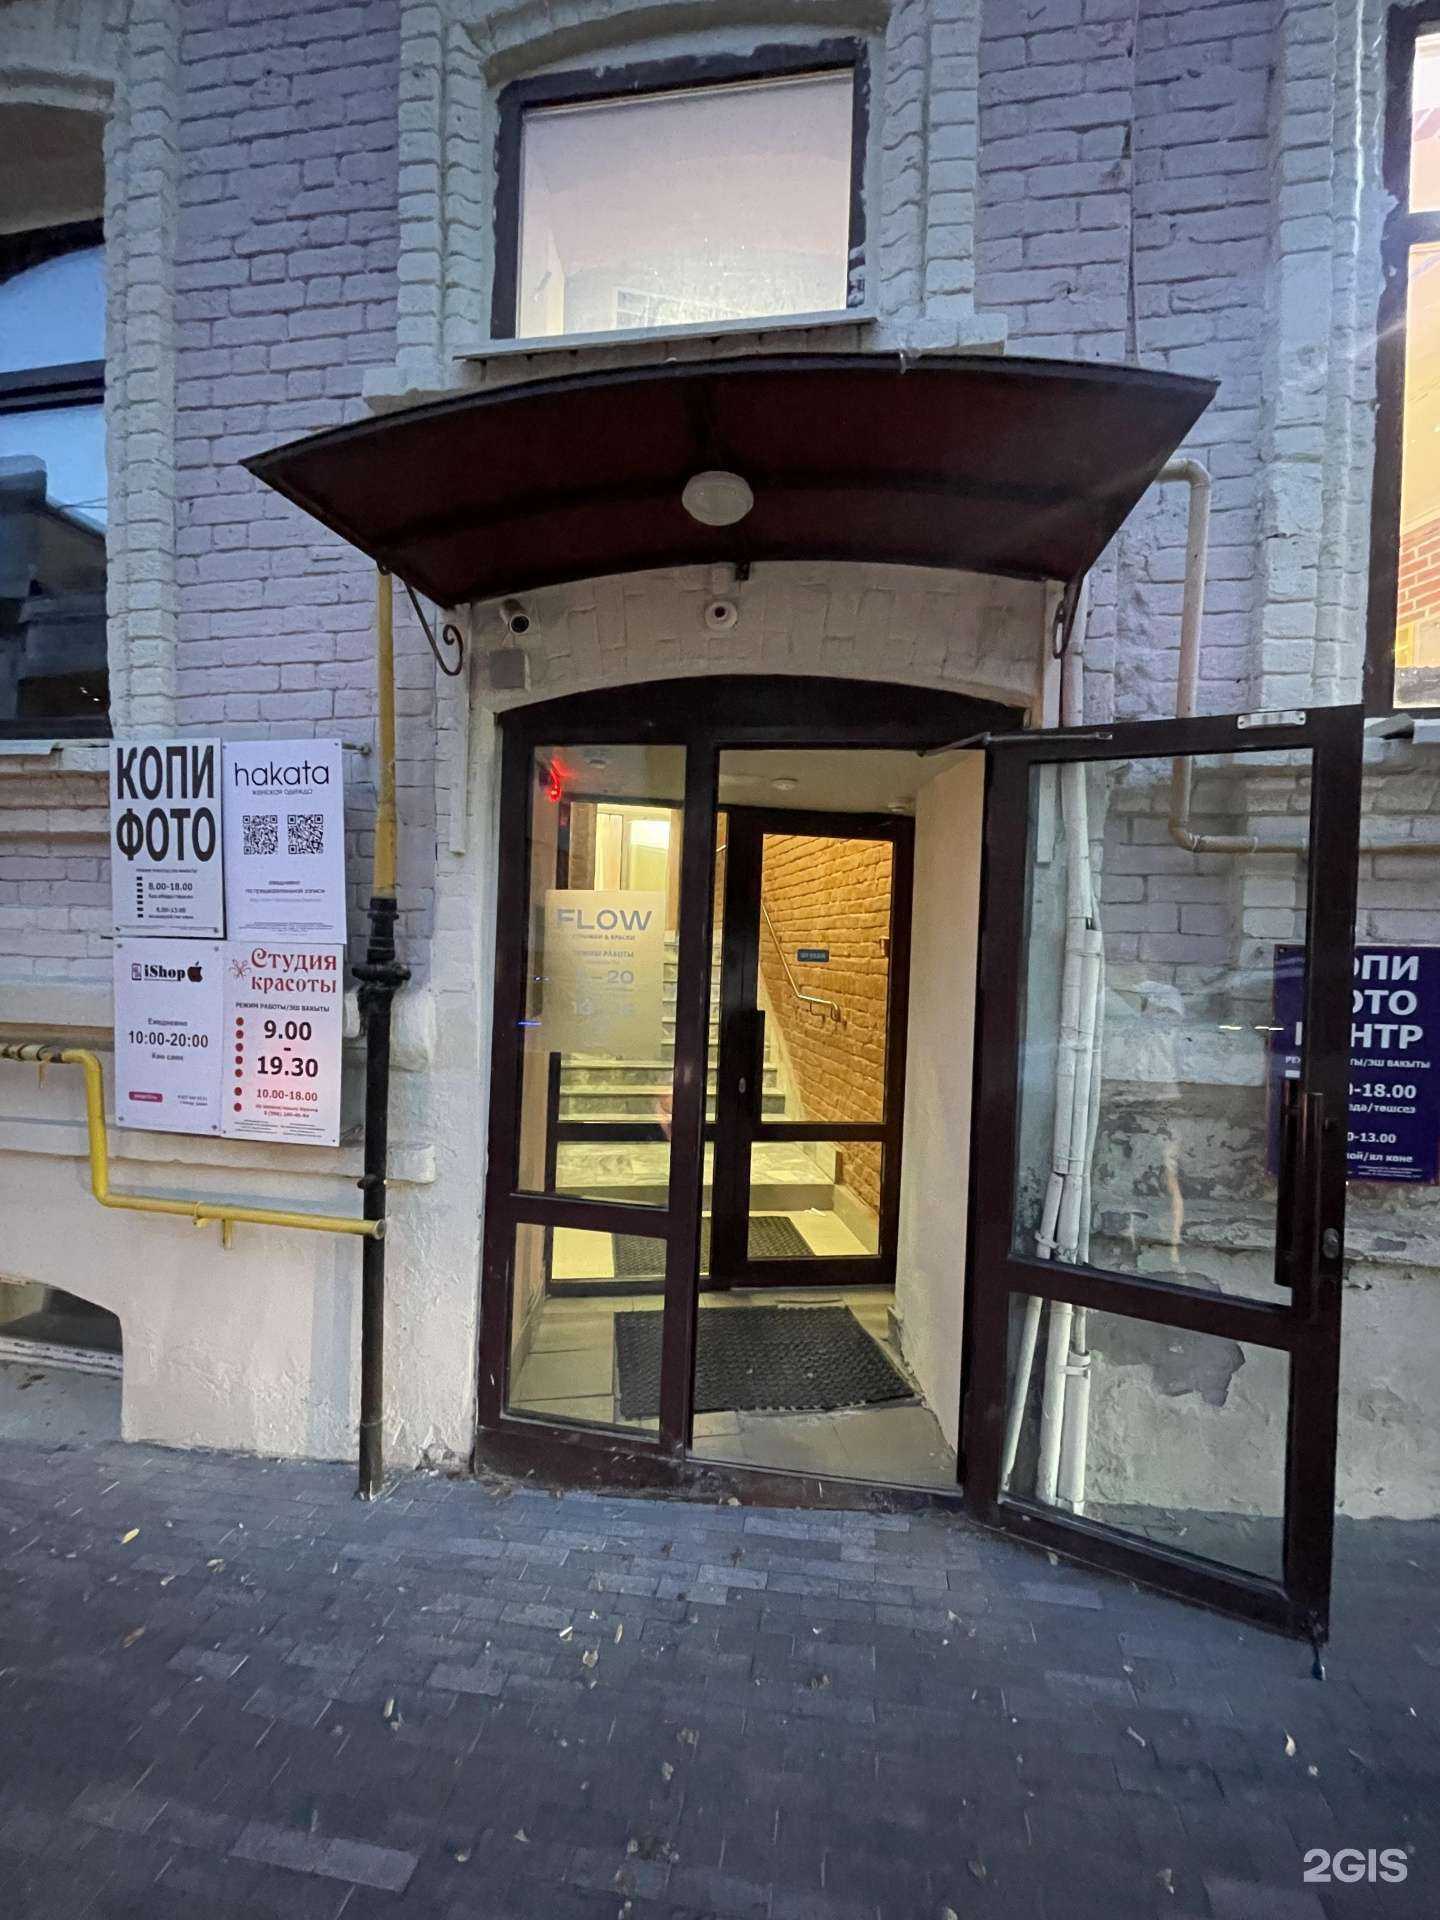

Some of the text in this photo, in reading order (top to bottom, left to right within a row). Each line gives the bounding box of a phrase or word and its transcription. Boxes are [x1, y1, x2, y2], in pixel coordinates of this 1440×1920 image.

[116, 745, 215, 801] КОПИ
[234, 760, 330, 787] hakata
[116, 806, 217, 863] ФОТО
[557, 909, 653, 931] FLOW
[250, 947, 337, 973] Студия
[1352, 954, 1420, 981] ПИ
[144, 963, 186, 981] iShop
[250, 975, 337, 994] красоты
[128, 1030, 209, 1048] 10:00-20:00
[263, 1019, 312, 1041] 9.00
[256, 1056, 319, 1078] 19.30
[256, 1089, 318, 1103] 10.00-18.00
[1348, 1083, 1417, 1099] -18.00
[1347, 1131, 1397, 1143] 0-13.00
